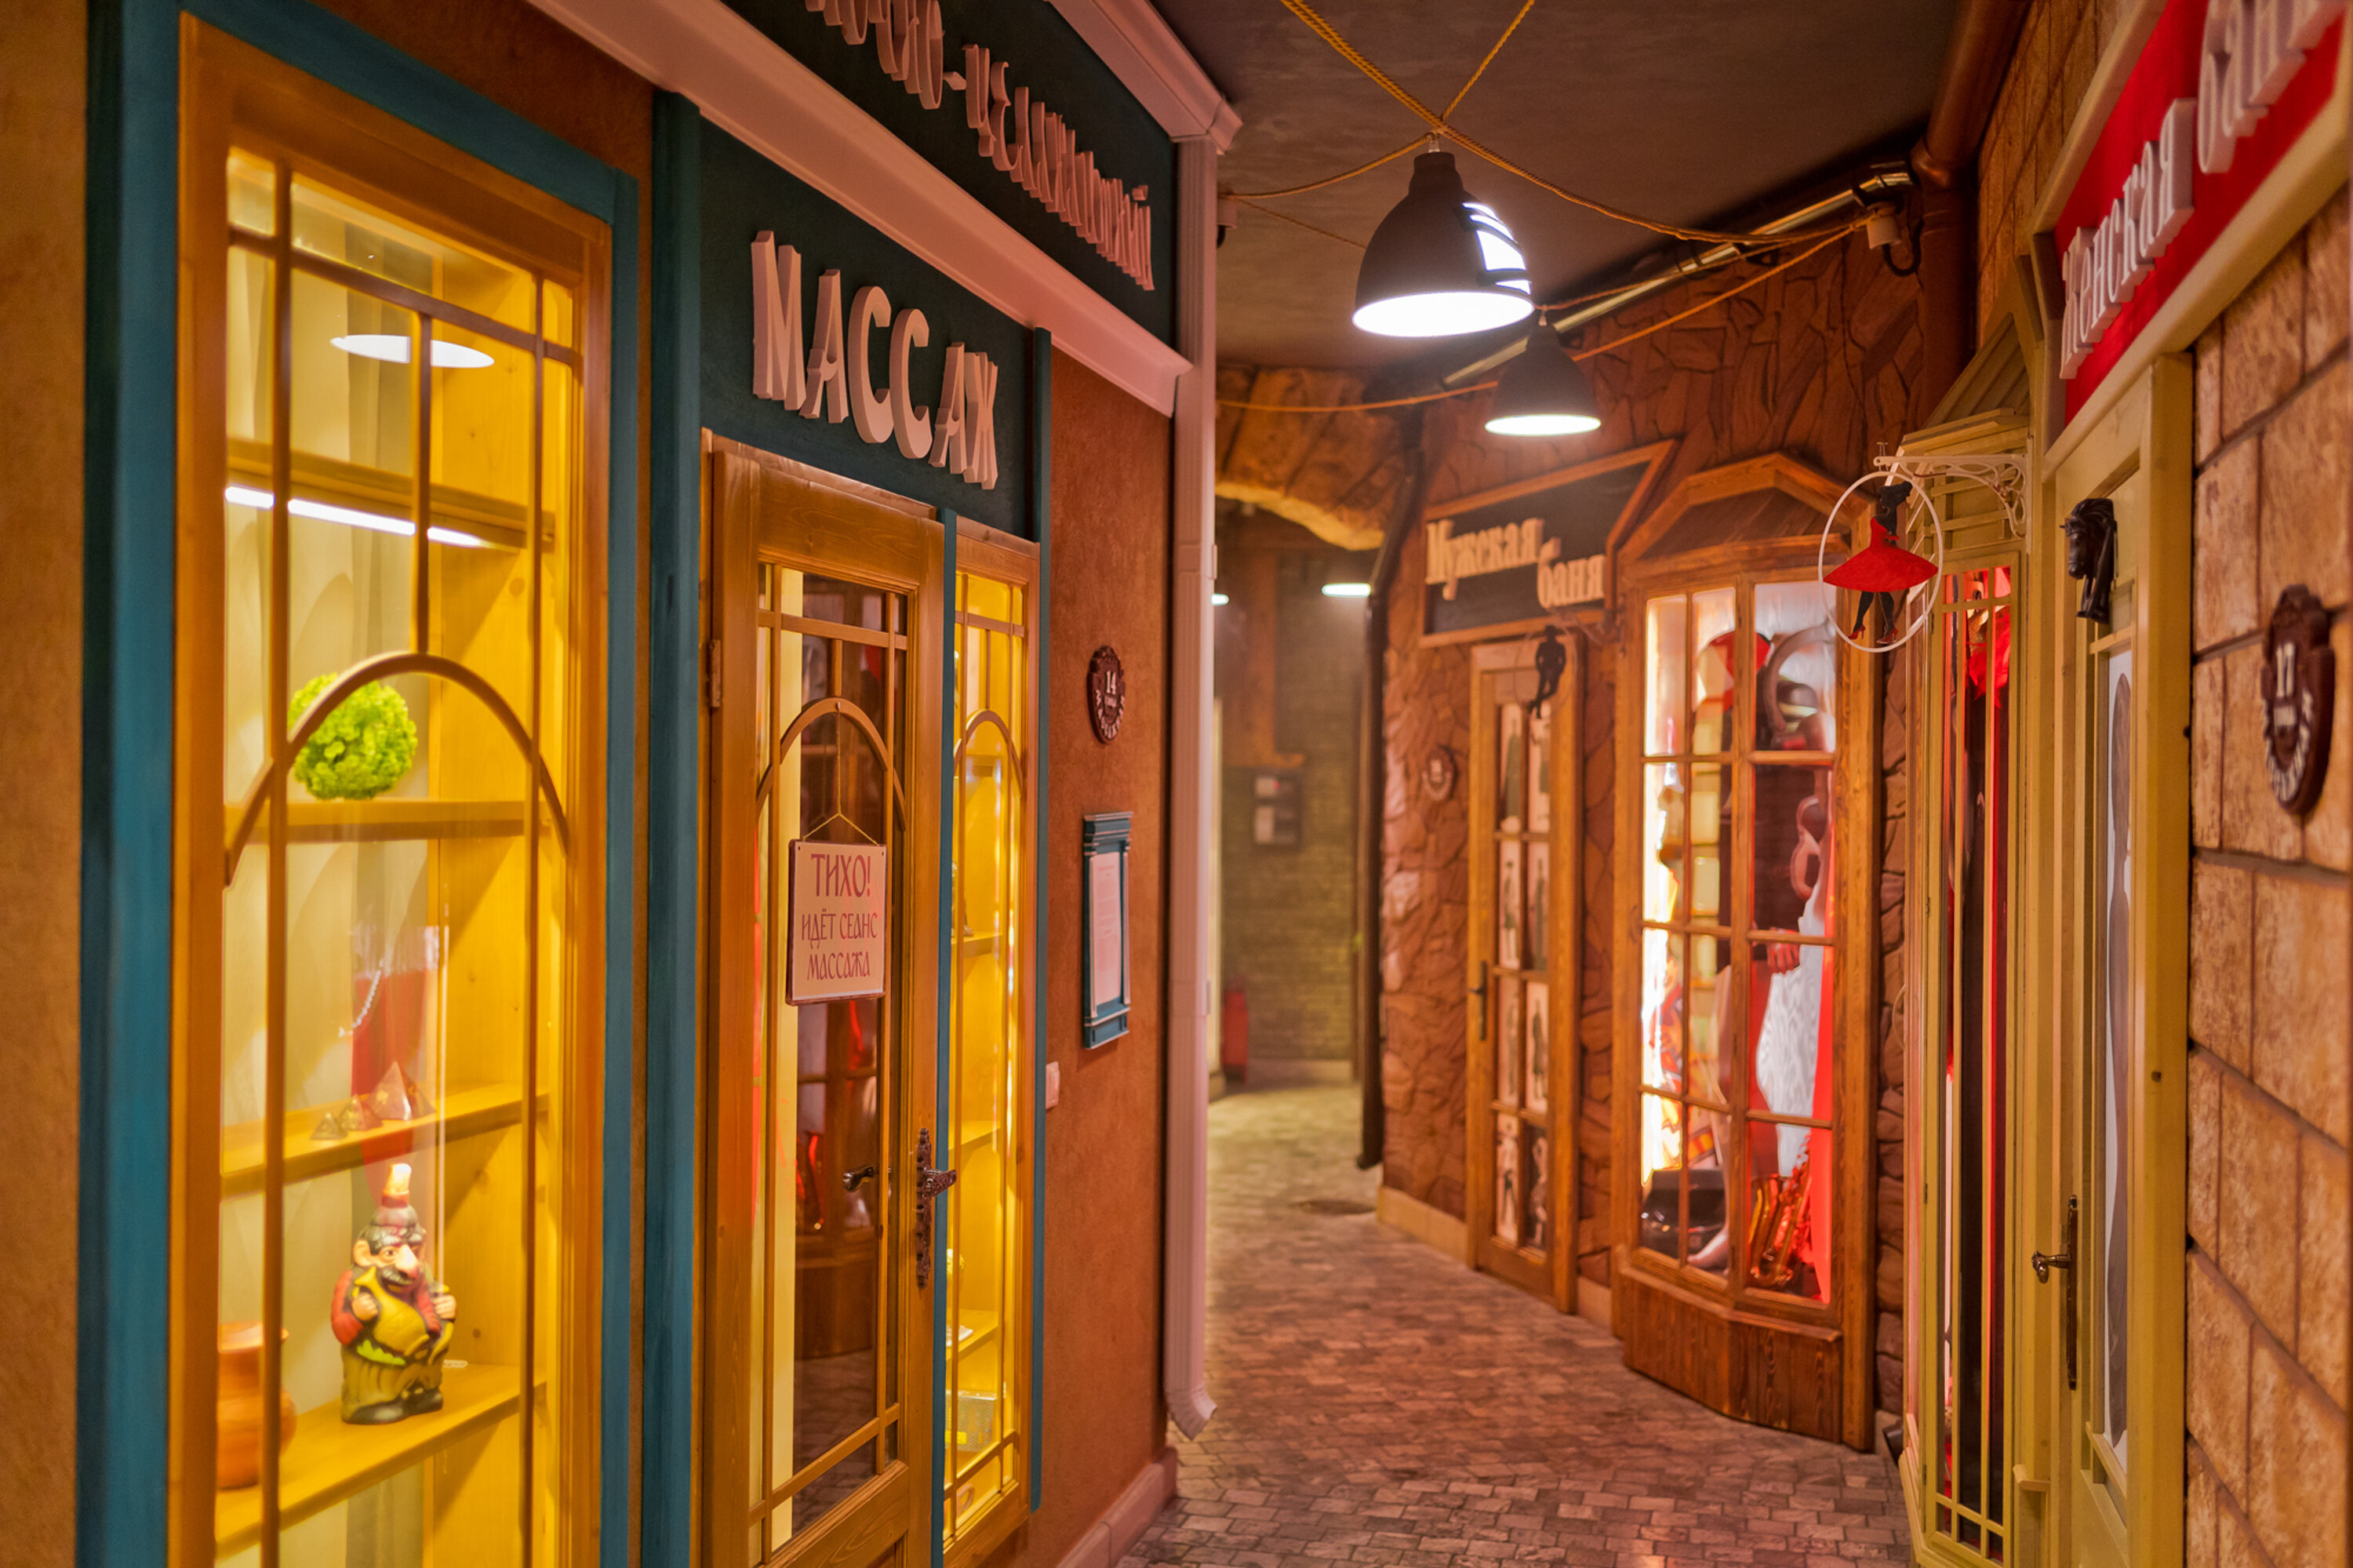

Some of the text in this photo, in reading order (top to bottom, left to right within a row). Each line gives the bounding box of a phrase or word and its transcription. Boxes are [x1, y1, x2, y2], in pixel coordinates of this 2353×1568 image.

[751, 230, 998, 490] МАССАЖ
[1105, 670, 1117, 694] 14
[810, 853, 871, 897] ТИХО!
[801, 908, 836, 949] ИДЁТ
